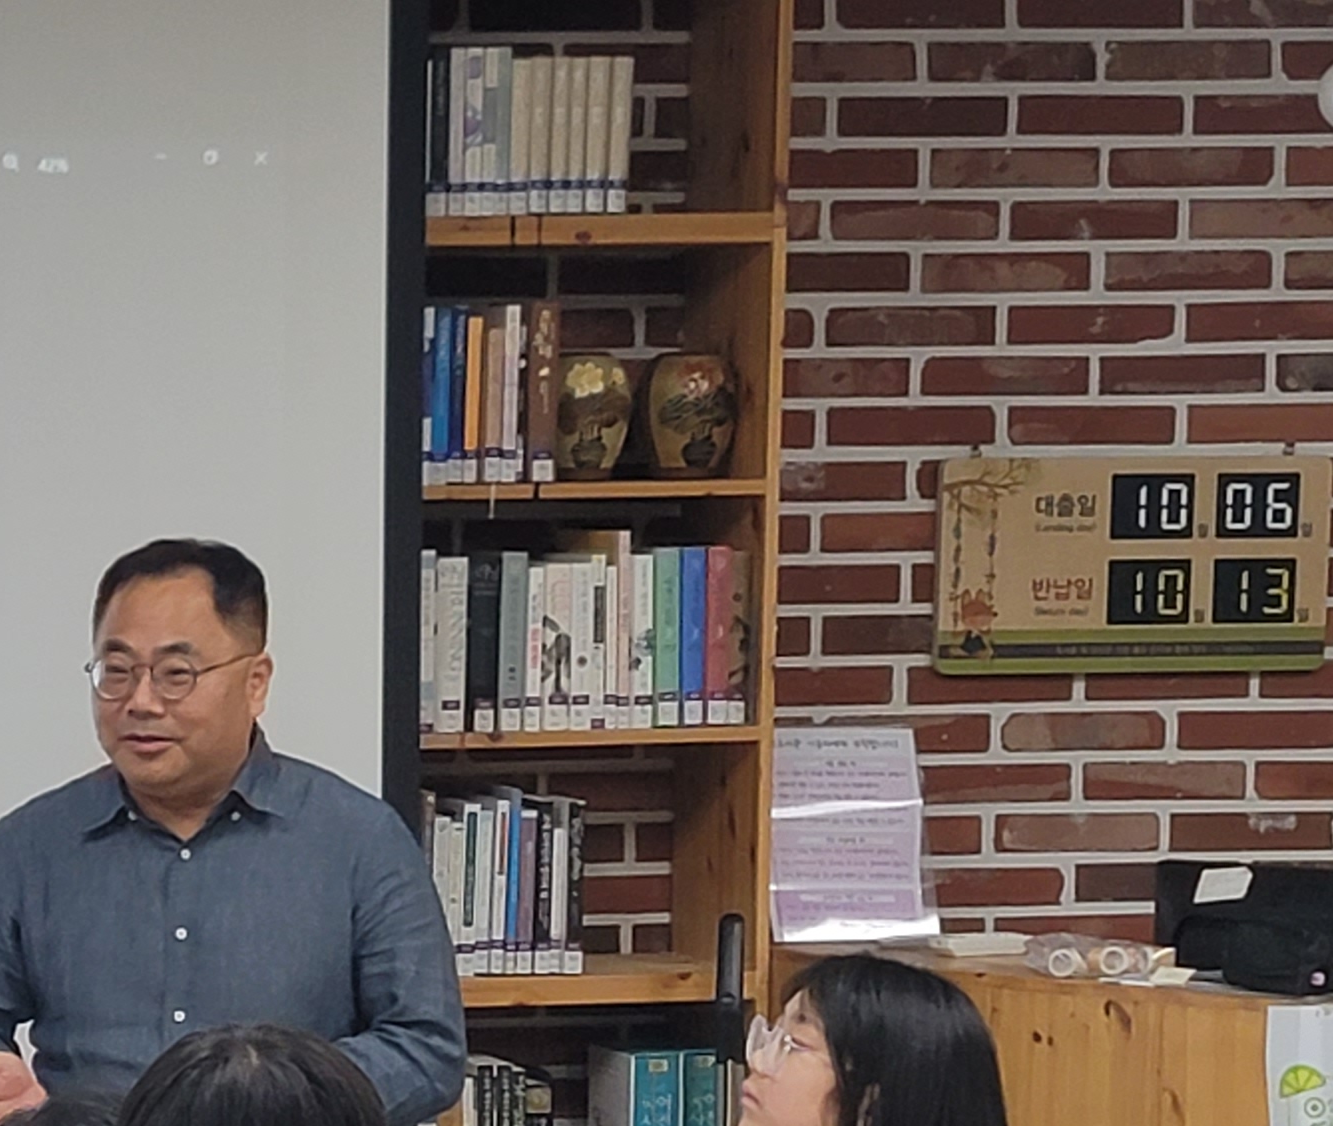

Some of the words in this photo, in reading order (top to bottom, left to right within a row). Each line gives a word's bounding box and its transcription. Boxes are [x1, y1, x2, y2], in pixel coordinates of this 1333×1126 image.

[1034, 492, 1097, 518] 대출일
[1137, 482, 1189, 531] 10
[1224, 482, 1294, 531] 06
[1032, 577, 1094, 602] 반납일
[1133, 568, 1185, 616] 10
[1238, 567, 1290, 615] 13
